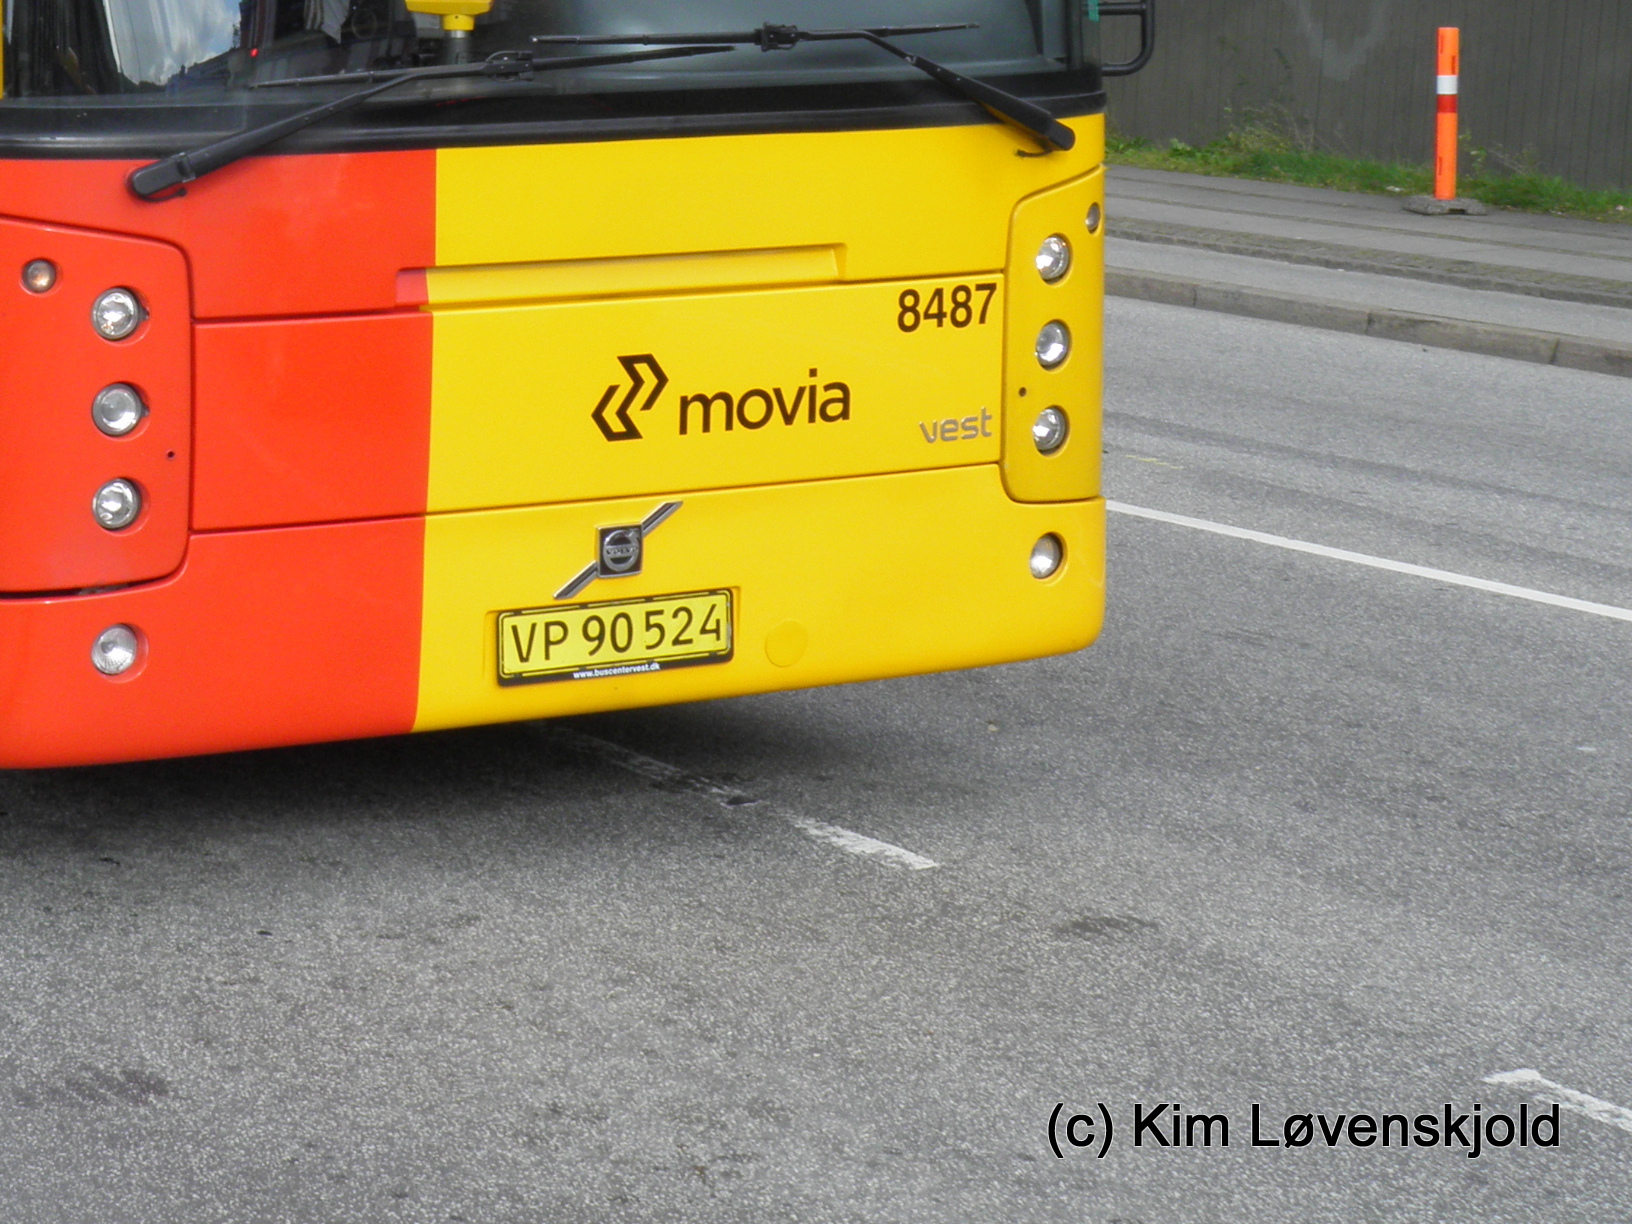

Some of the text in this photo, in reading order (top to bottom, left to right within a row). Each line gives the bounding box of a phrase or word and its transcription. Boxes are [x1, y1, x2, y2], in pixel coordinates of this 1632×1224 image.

[897, 282, 997, 333] 8487
[679, 367, 851, 436] movia
[918, 406, 993, 444] vest
[511, 603, 721, 663] VP 90 524
[573, 661, 661, 680] www.buscentervest.dk
